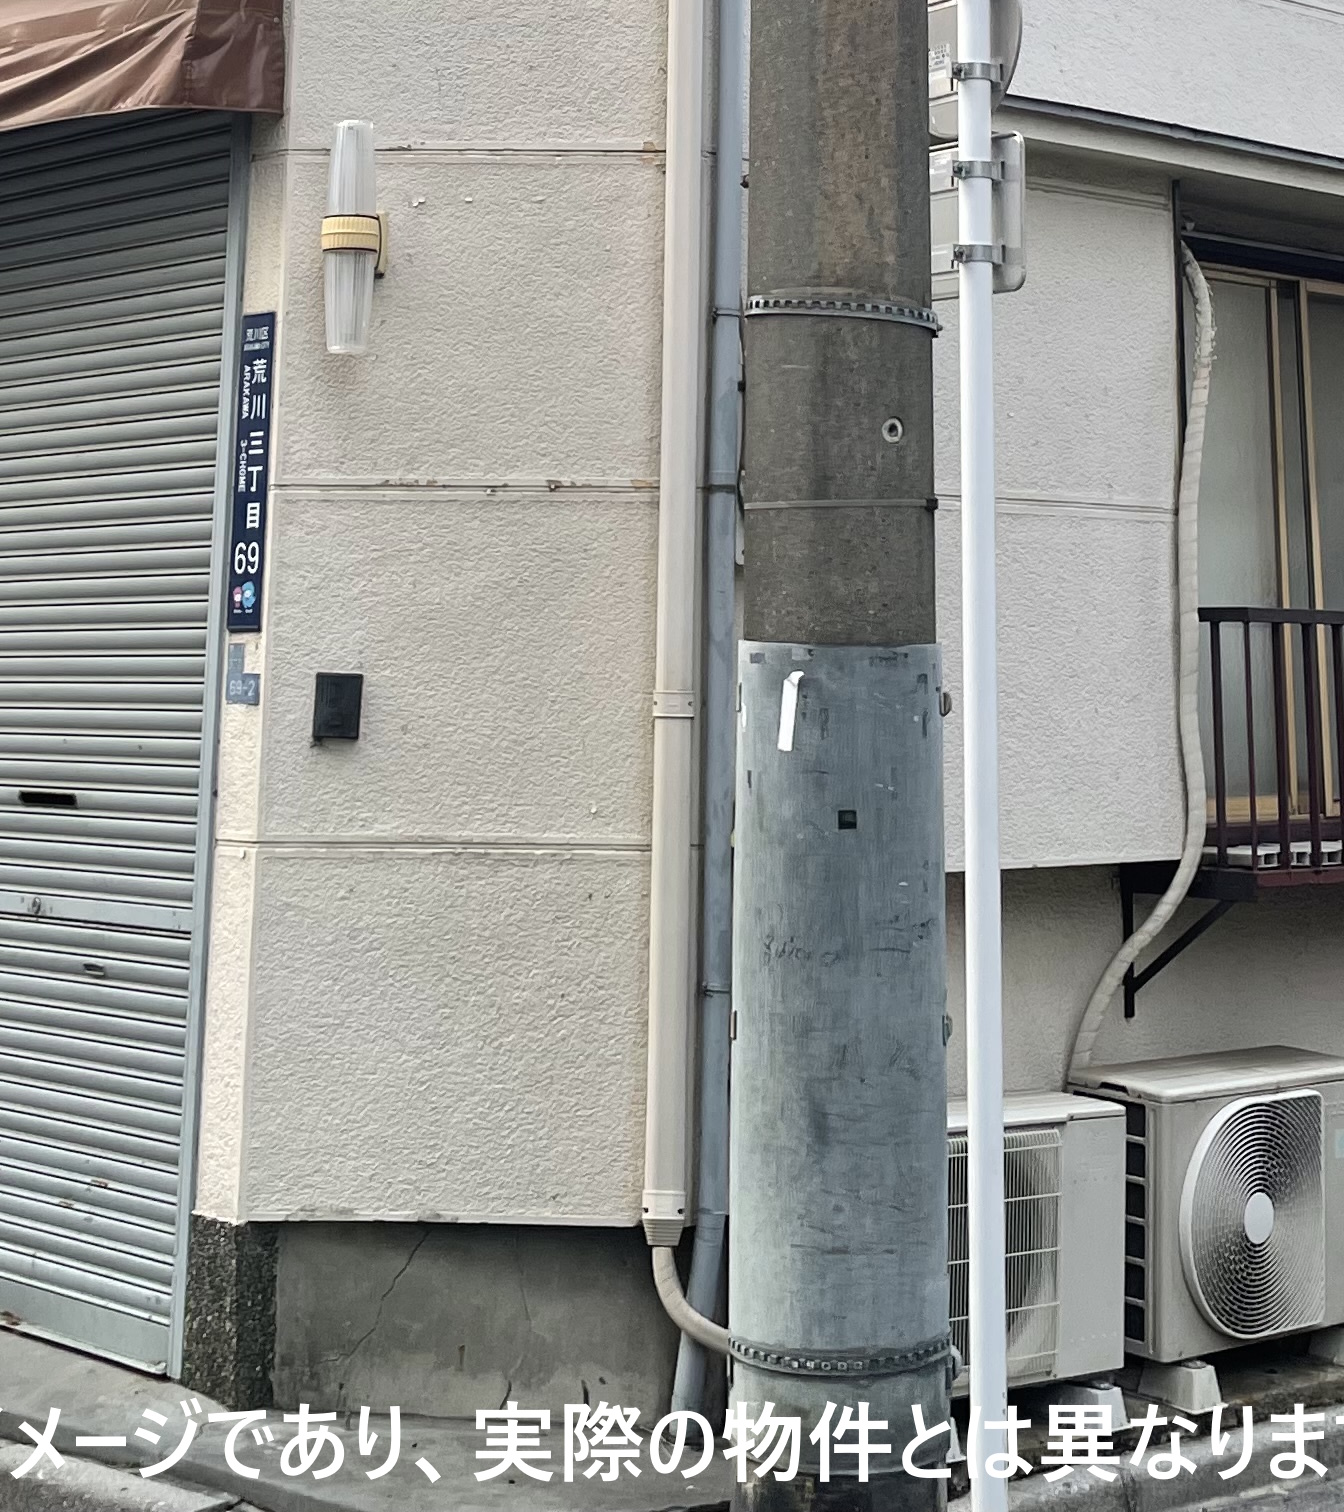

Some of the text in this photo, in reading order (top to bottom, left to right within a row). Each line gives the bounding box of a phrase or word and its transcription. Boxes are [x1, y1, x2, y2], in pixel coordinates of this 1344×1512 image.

[237, 364, 252, 493] ARAKAWA 3-CHOME
[246, 357, 268, 529] 荒川三丁目
[234, 541, 260, 575] 69
[229, 679, 256, 697] 69-2
